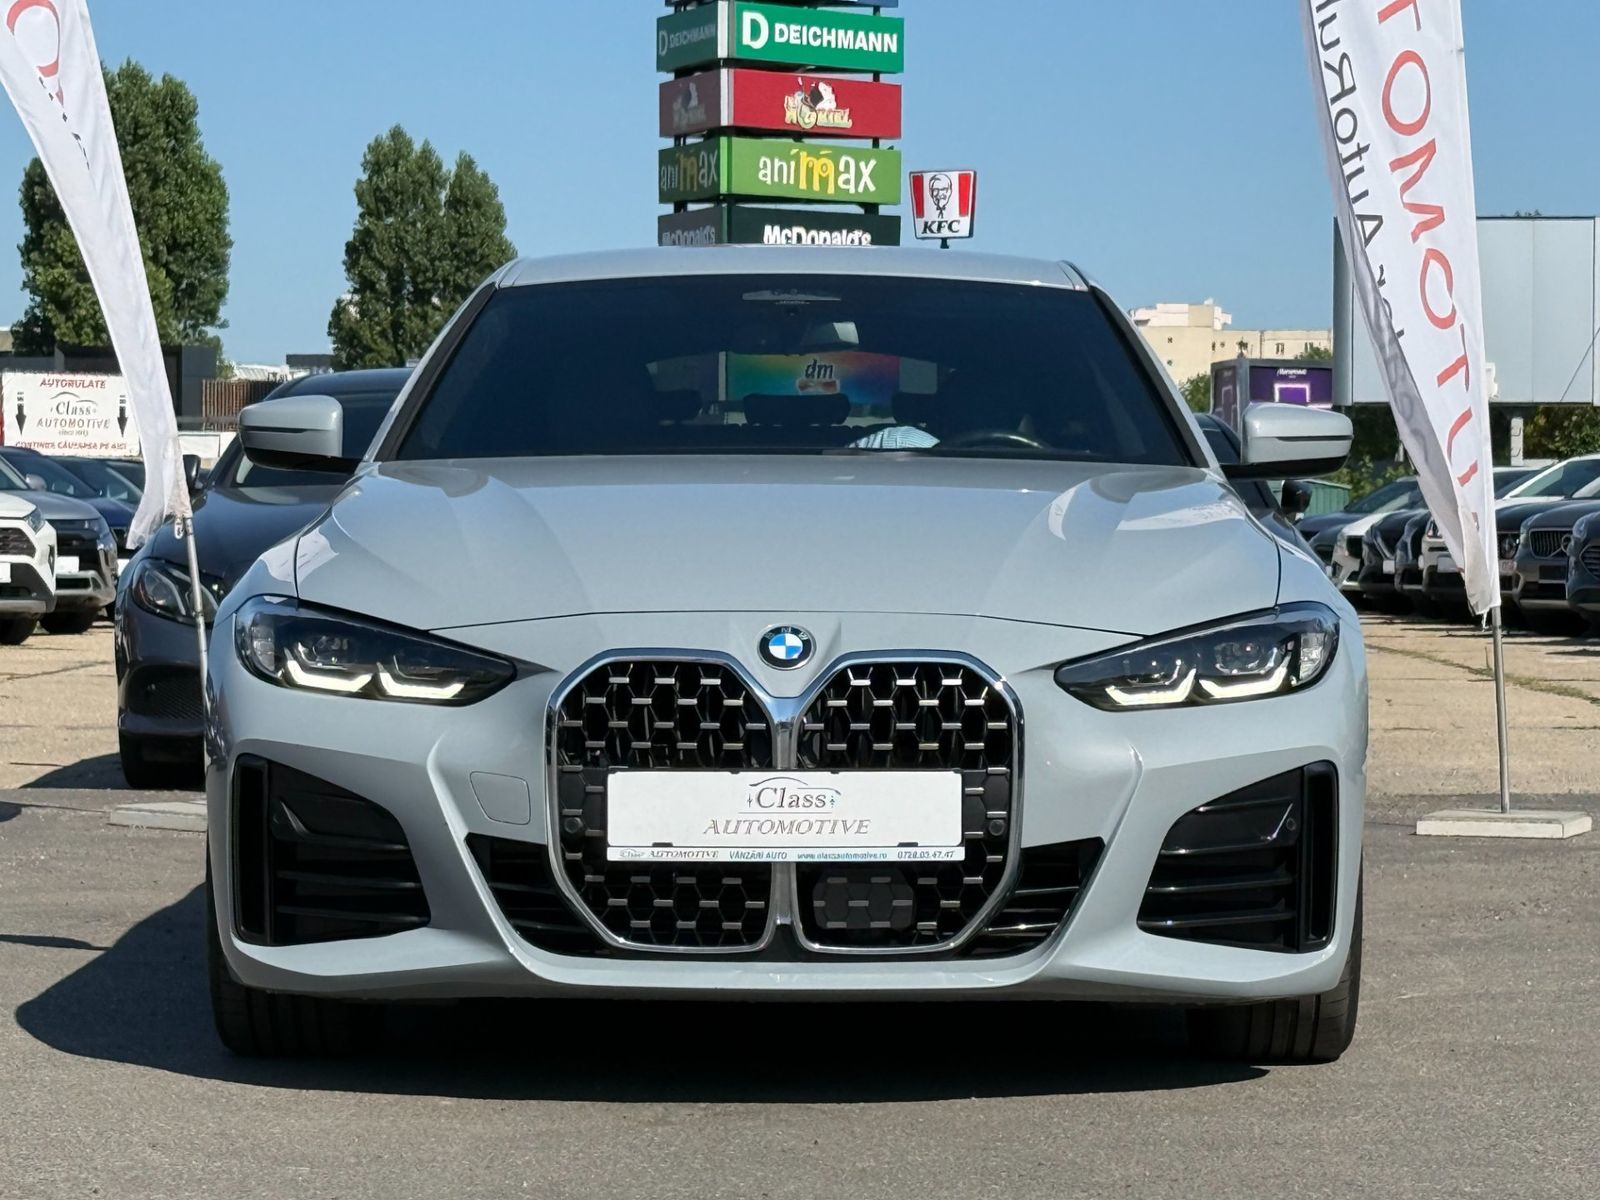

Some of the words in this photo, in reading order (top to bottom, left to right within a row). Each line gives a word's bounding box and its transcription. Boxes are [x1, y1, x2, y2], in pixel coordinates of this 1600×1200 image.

[775, 22, 898, 53] DEICHMANN
[763, 225, 872, 245] McDonald's
[921, 220, 960, 234] KFC
[805, 359, 833, 379] dm
[56, 400, 91, 415] Class
[37, 418, 110, 429] AUTOMOTIVE
[757, 787, 827, 809] Class
[703, 819, 871, 835] AUTOMOTIVE
[649, 850, 719, 859] AUTOMOTIVE
